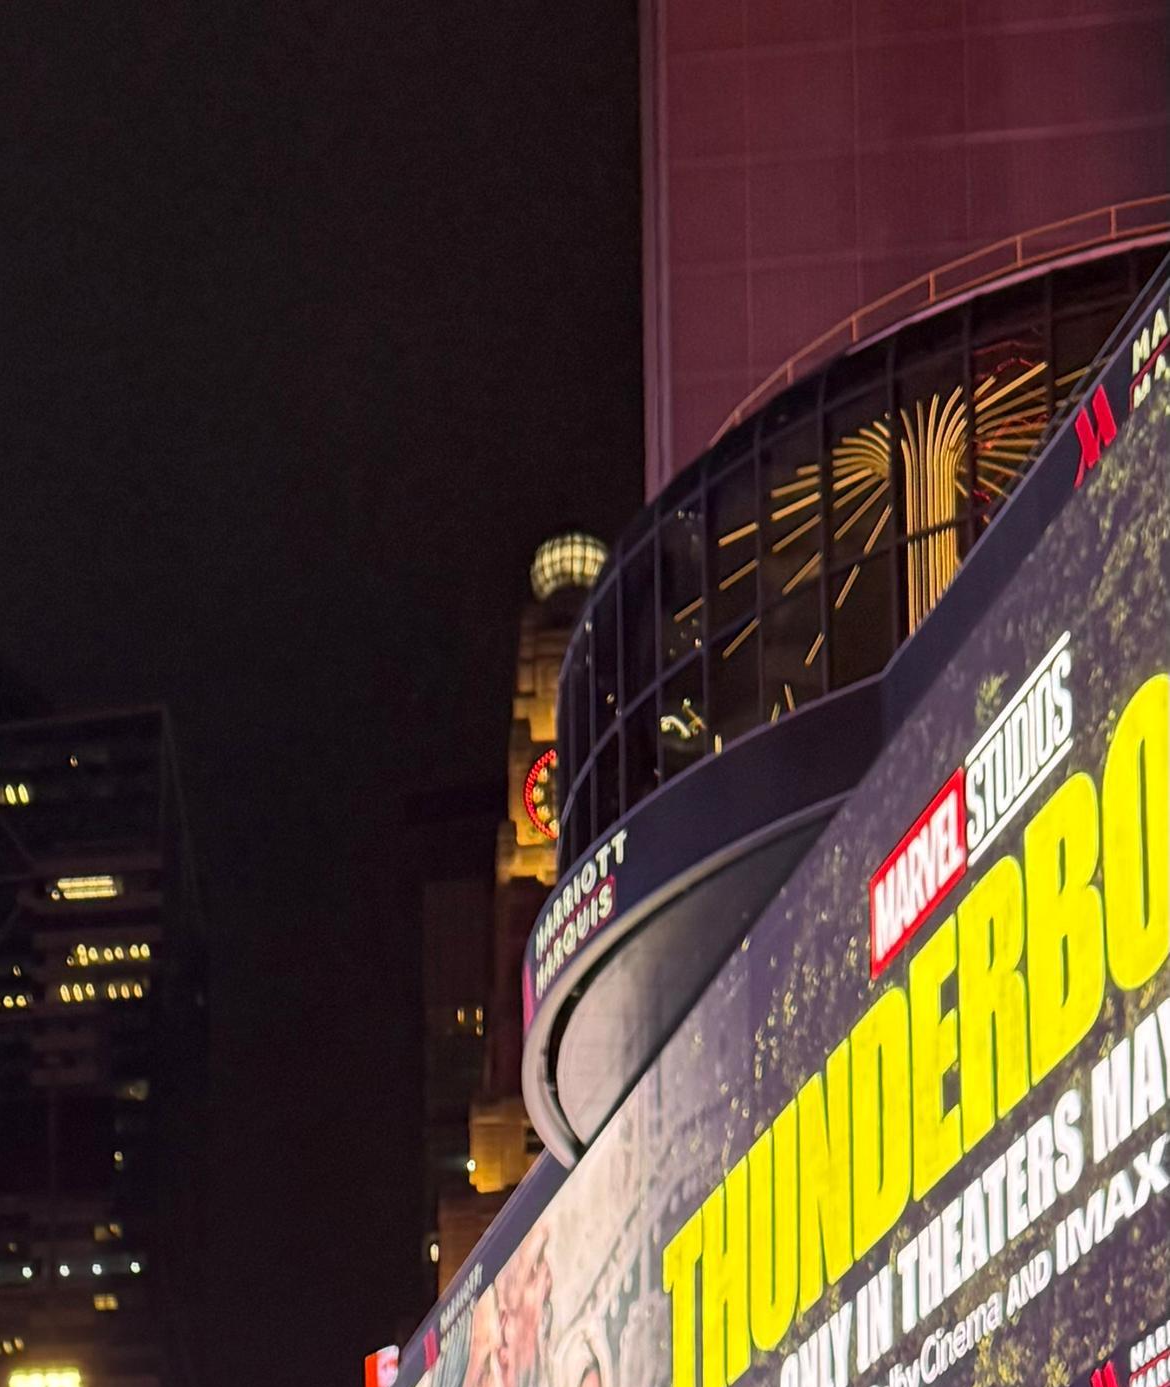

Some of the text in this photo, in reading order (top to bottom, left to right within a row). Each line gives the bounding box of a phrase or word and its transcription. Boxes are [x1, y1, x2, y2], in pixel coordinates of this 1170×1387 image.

[535, 829, 628, 961] MARRIOTT
[874, 649, 1073, 962] MARVEL STUDIOS
[535, 884, 613, 1000] MARQUIS
[856, 1264, 893, 1374] IN
[897, 1089, 1084, 1334] THEATERS
[919, 1292, 1003, 1385] Cinema
[1006, 1250, 1052, 1317] AND
[1055, 1132, 1170, 1275] IMAX
